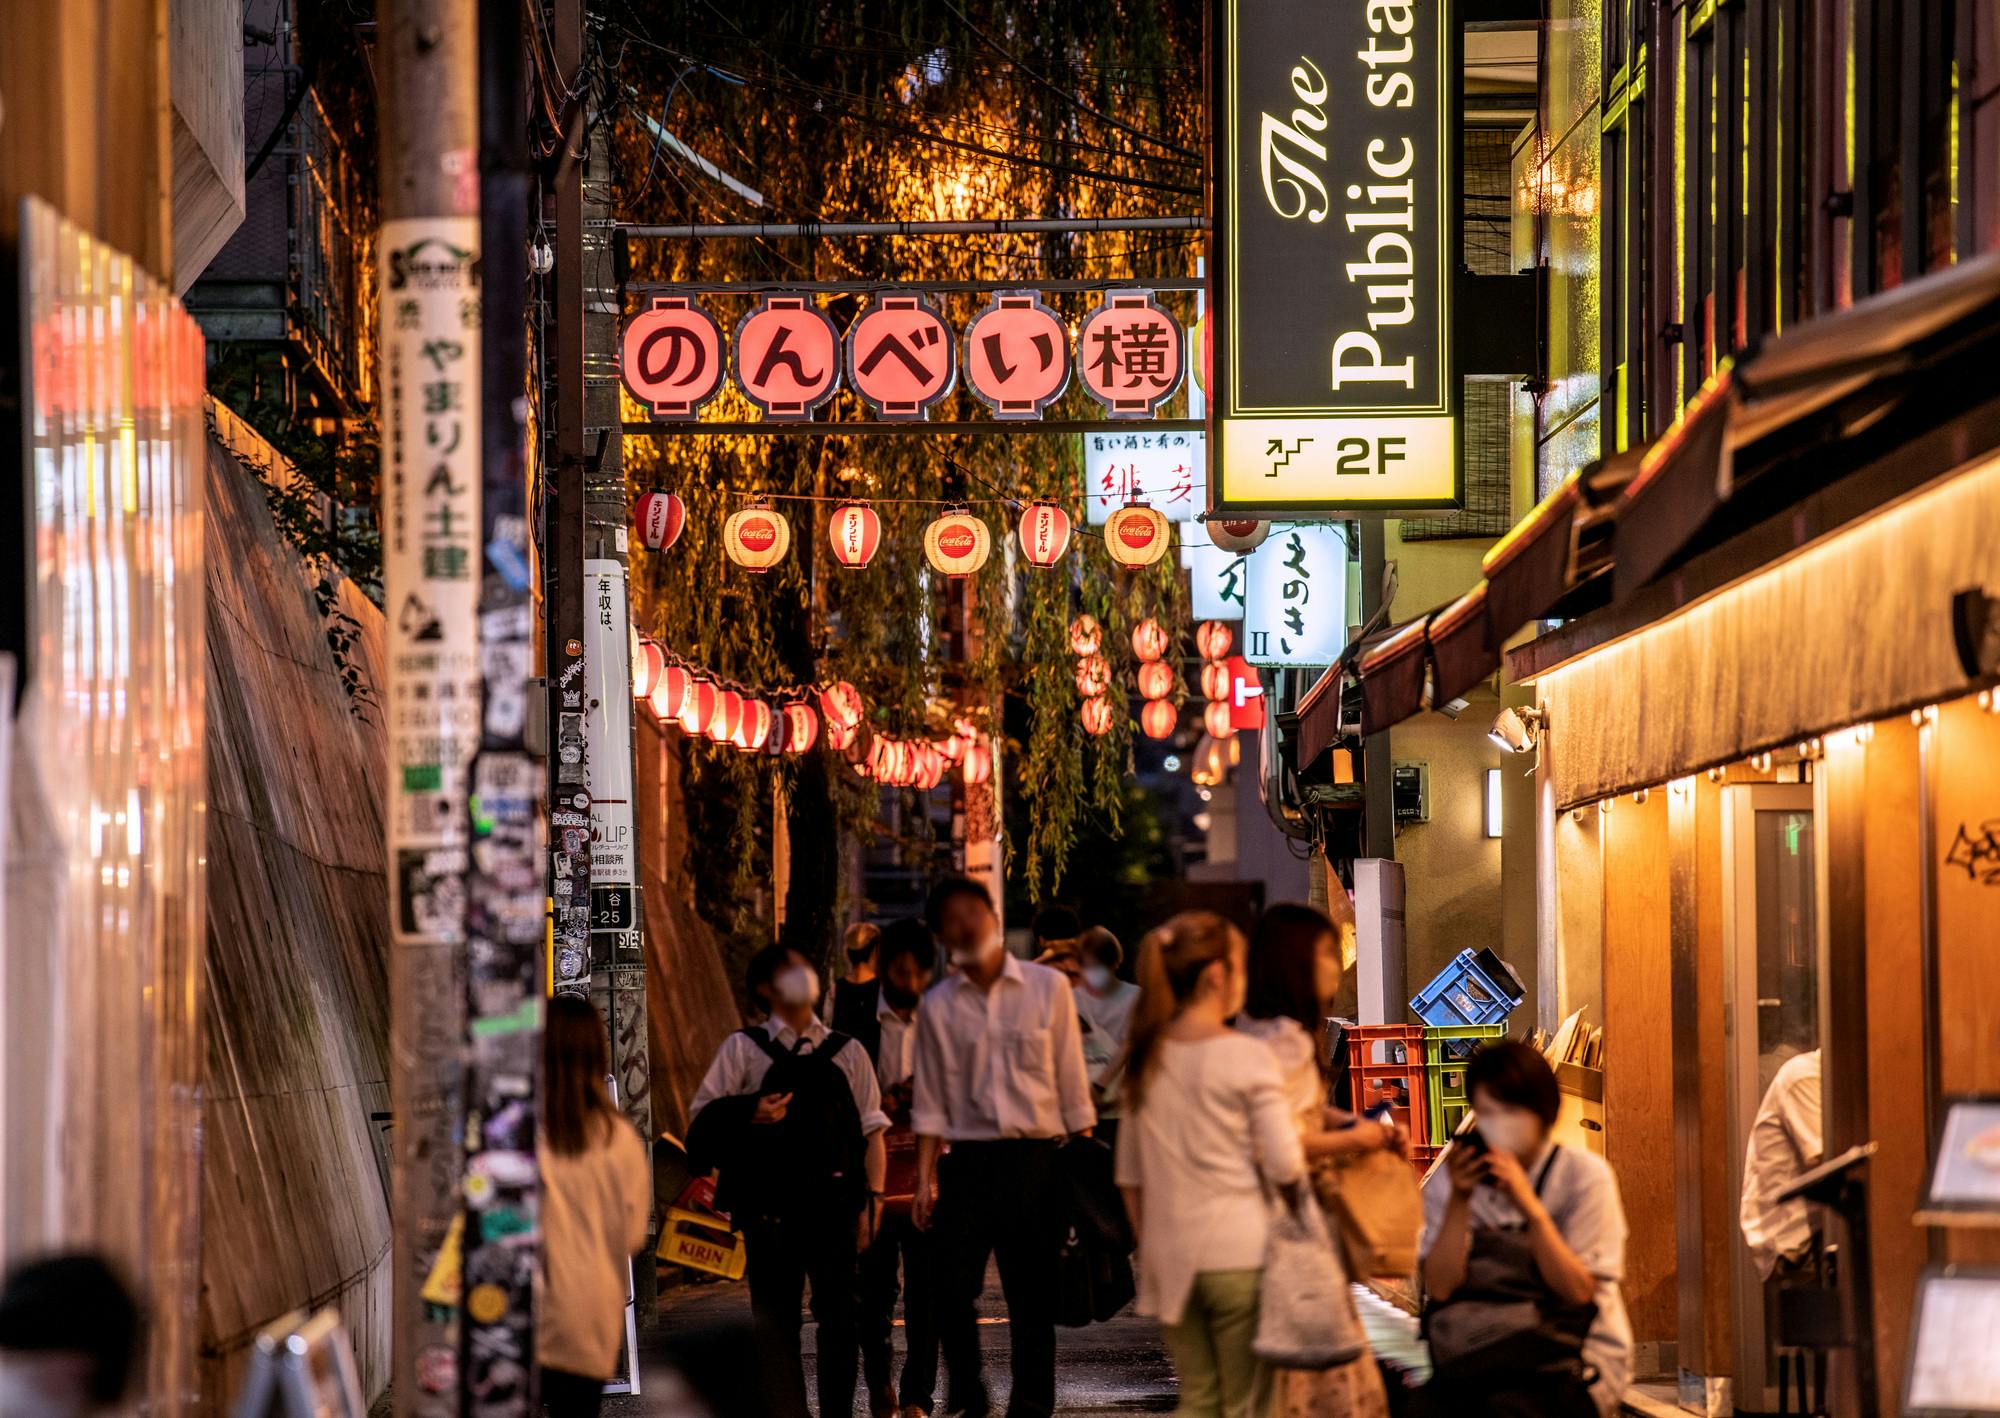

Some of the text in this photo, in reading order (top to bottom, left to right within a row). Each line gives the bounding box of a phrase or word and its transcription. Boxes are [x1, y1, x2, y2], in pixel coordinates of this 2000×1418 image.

[1260, 55, 1329, 224] The
[1331, 137, 1415, 391] Public
[1093, 433, 1191, 452] 旨い酒と肴の
[1335, 437, 1407, 476] 2F
[650, 500, 663, 539] キリンビール
[849, 513, 858, 553] キリンビール
[1038, 512, 1050, 553] キリンビール
[598, 578, 613, 632] 年収は、
[608, 893, 621, 907] 谷
[678, 1240, 725, 1264] KIRIN
